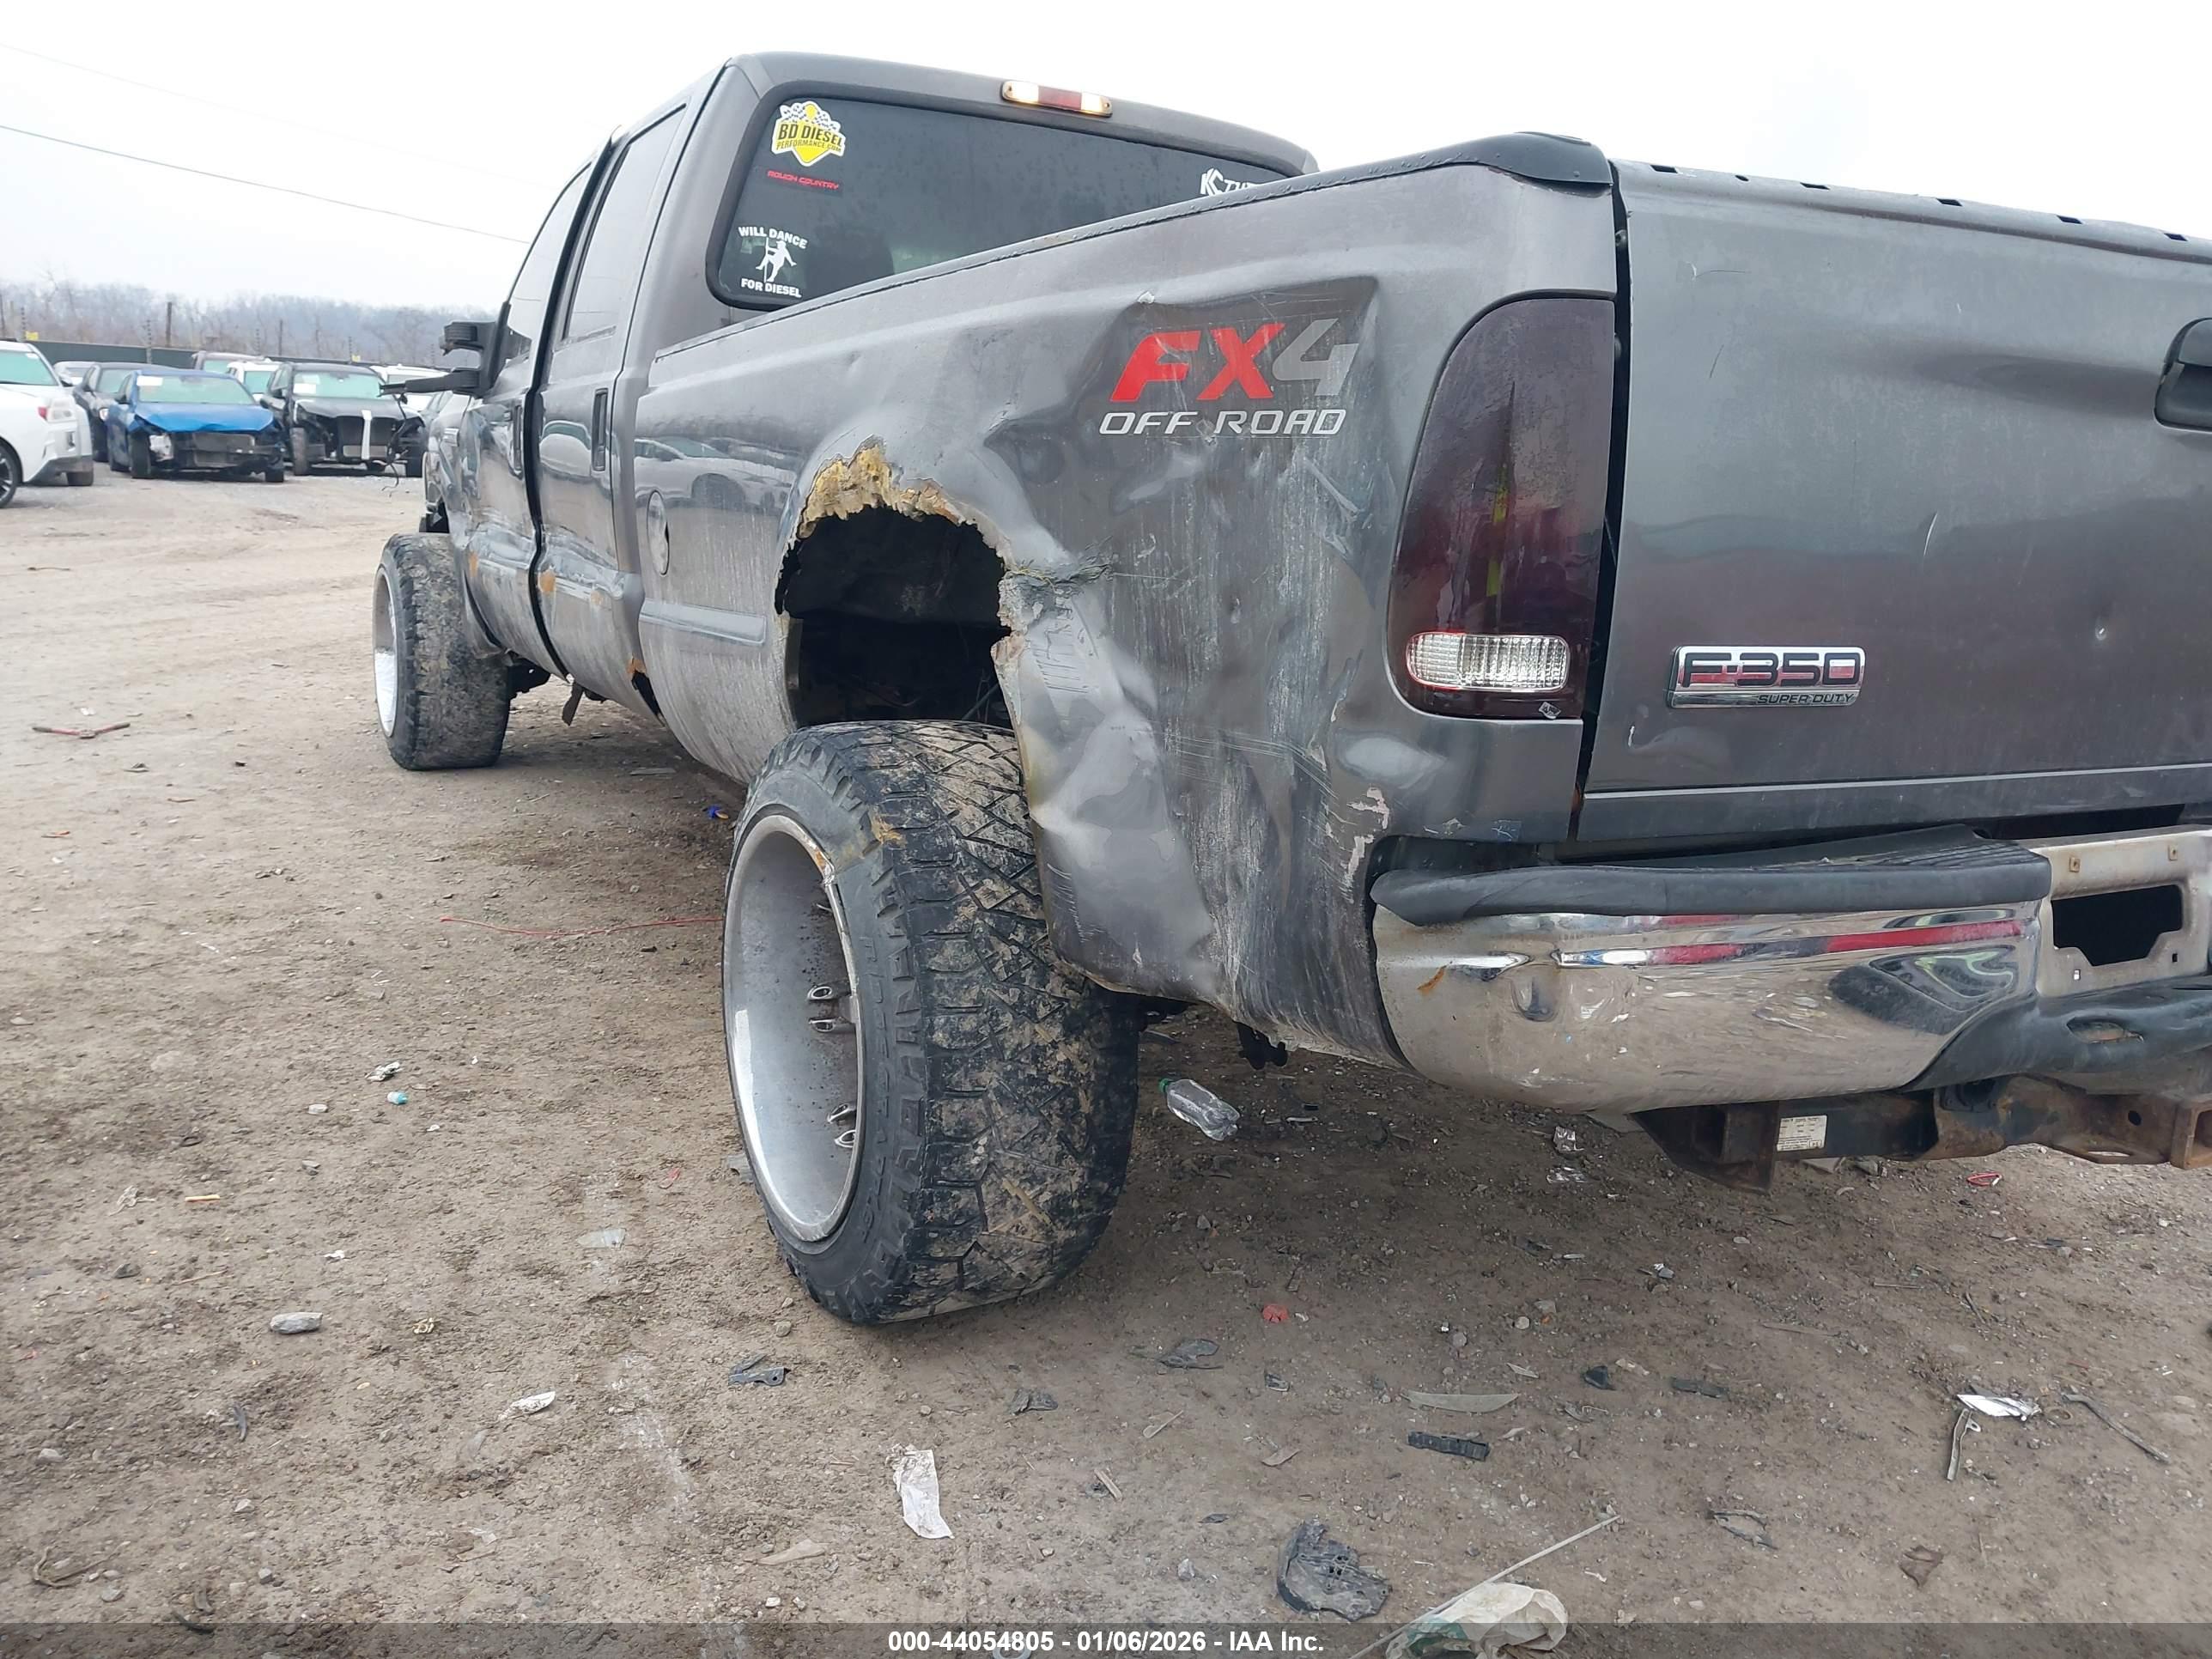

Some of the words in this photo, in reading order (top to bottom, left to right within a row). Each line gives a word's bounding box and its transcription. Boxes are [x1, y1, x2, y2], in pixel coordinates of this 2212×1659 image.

[778, 124, 799, 140] BD
[801, 125, 842, 147] DIESEL
[799, 177, 839, 190] COUNTRY
[738, 226, 767, 237] WILL
[769, 228, 808, 249] DANCE
[741, 277, 763, 291] FOR
[765, 282, 802, 298] DIESEL
[1109, 318, 1359, 403] FX4
[1099, 411, 1199, 435] OFF
[1212, 409, 1346, 435] ROAD
[1681, 652, 1861, 688] F-350
[1758, 694, 1811, 704] SUPER
[1812, 693, 1855, 703] DUTY
